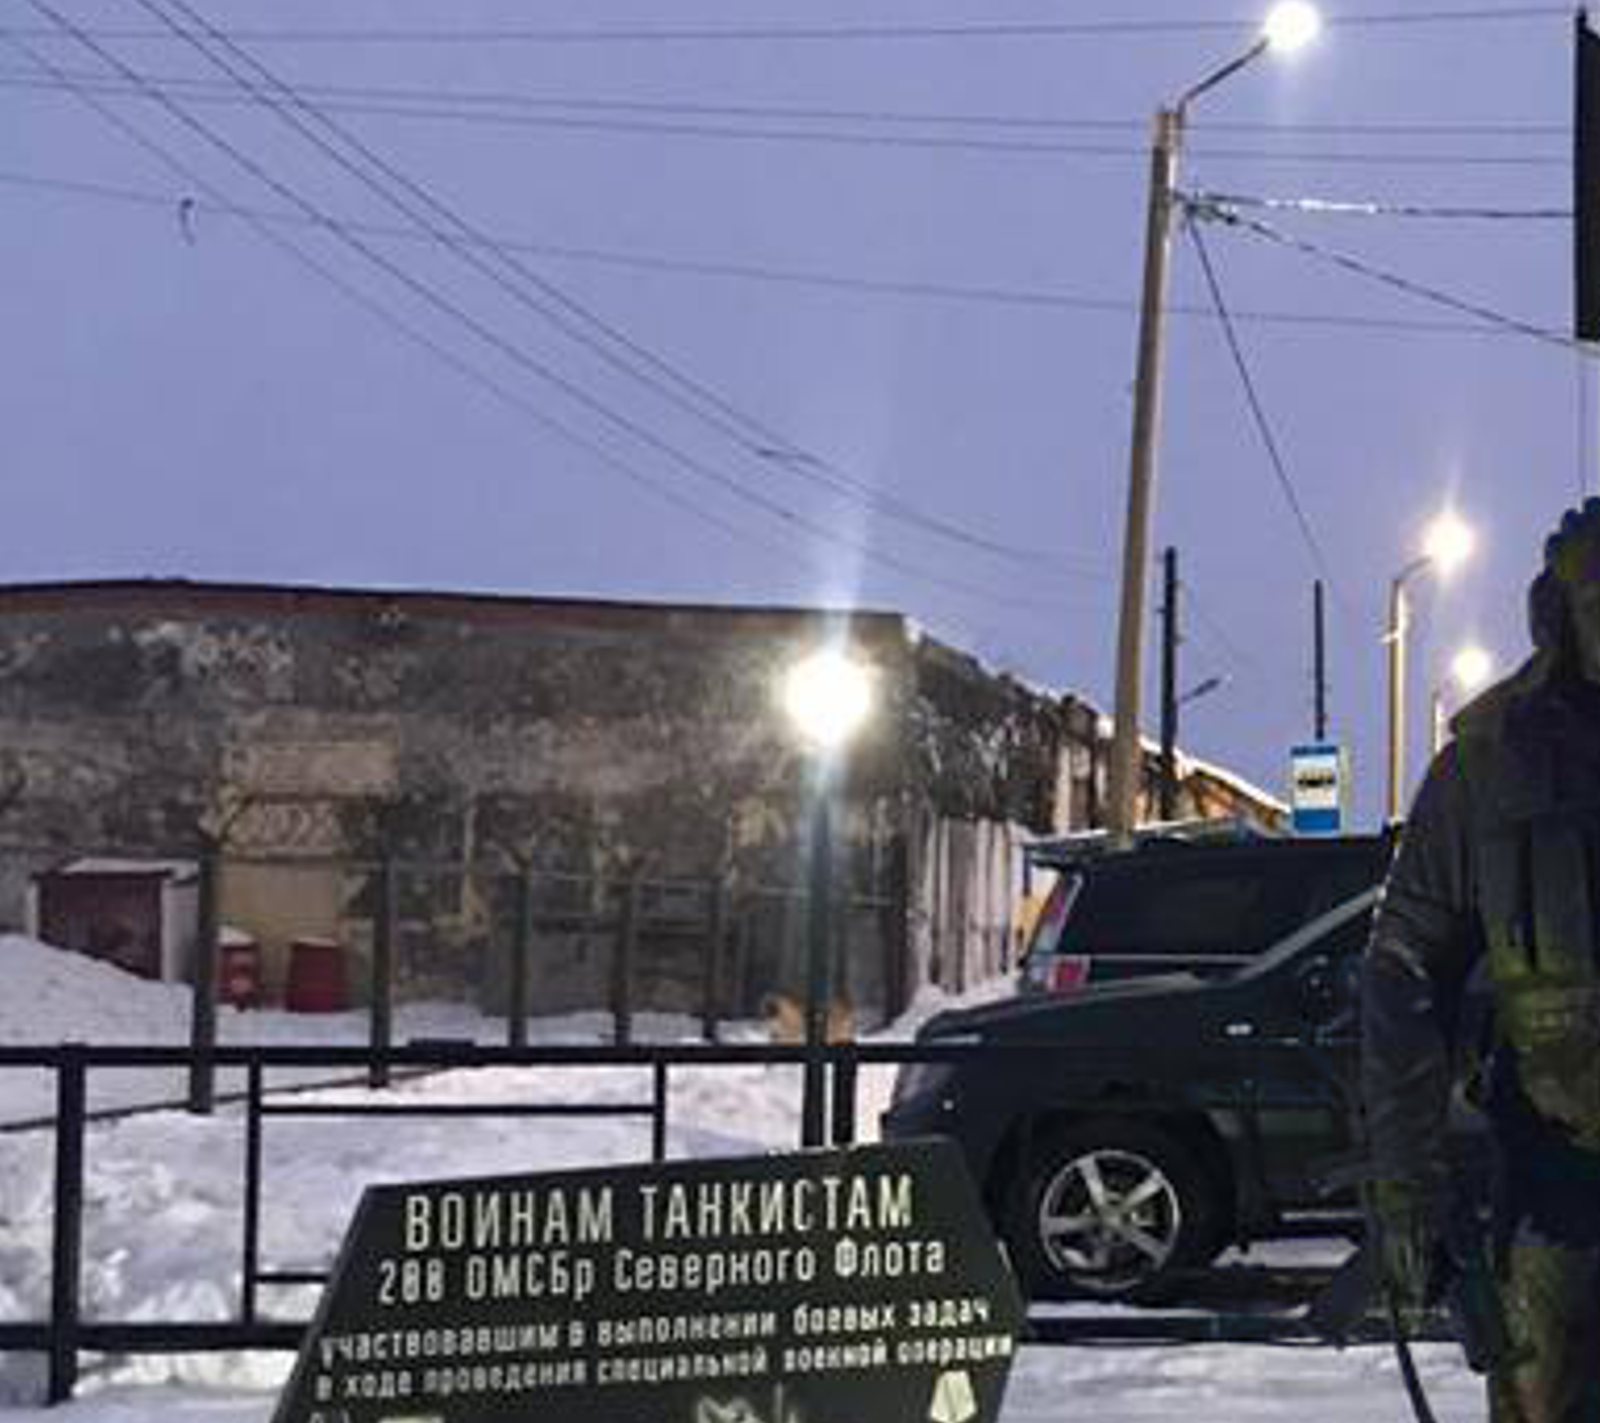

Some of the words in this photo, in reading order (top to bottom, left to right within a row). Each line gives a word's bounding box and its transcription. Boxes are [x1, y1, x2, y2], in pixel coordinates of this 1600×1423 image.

[405, 1185, 612, 1251] ВОИНАМ
[639, 1174, 913, 1240] ТАНКИСТАМ
[466, 1249, 596, 1302] ОМСБр
[614, 1244, 816, 1294] Северного
[834, 1236, 946, 1278] Флота
[598, 1310, 776, 1348] выполнении
[794, 1302, 896, 1336] боевых
[910, 1296, 989, 1328] задач
